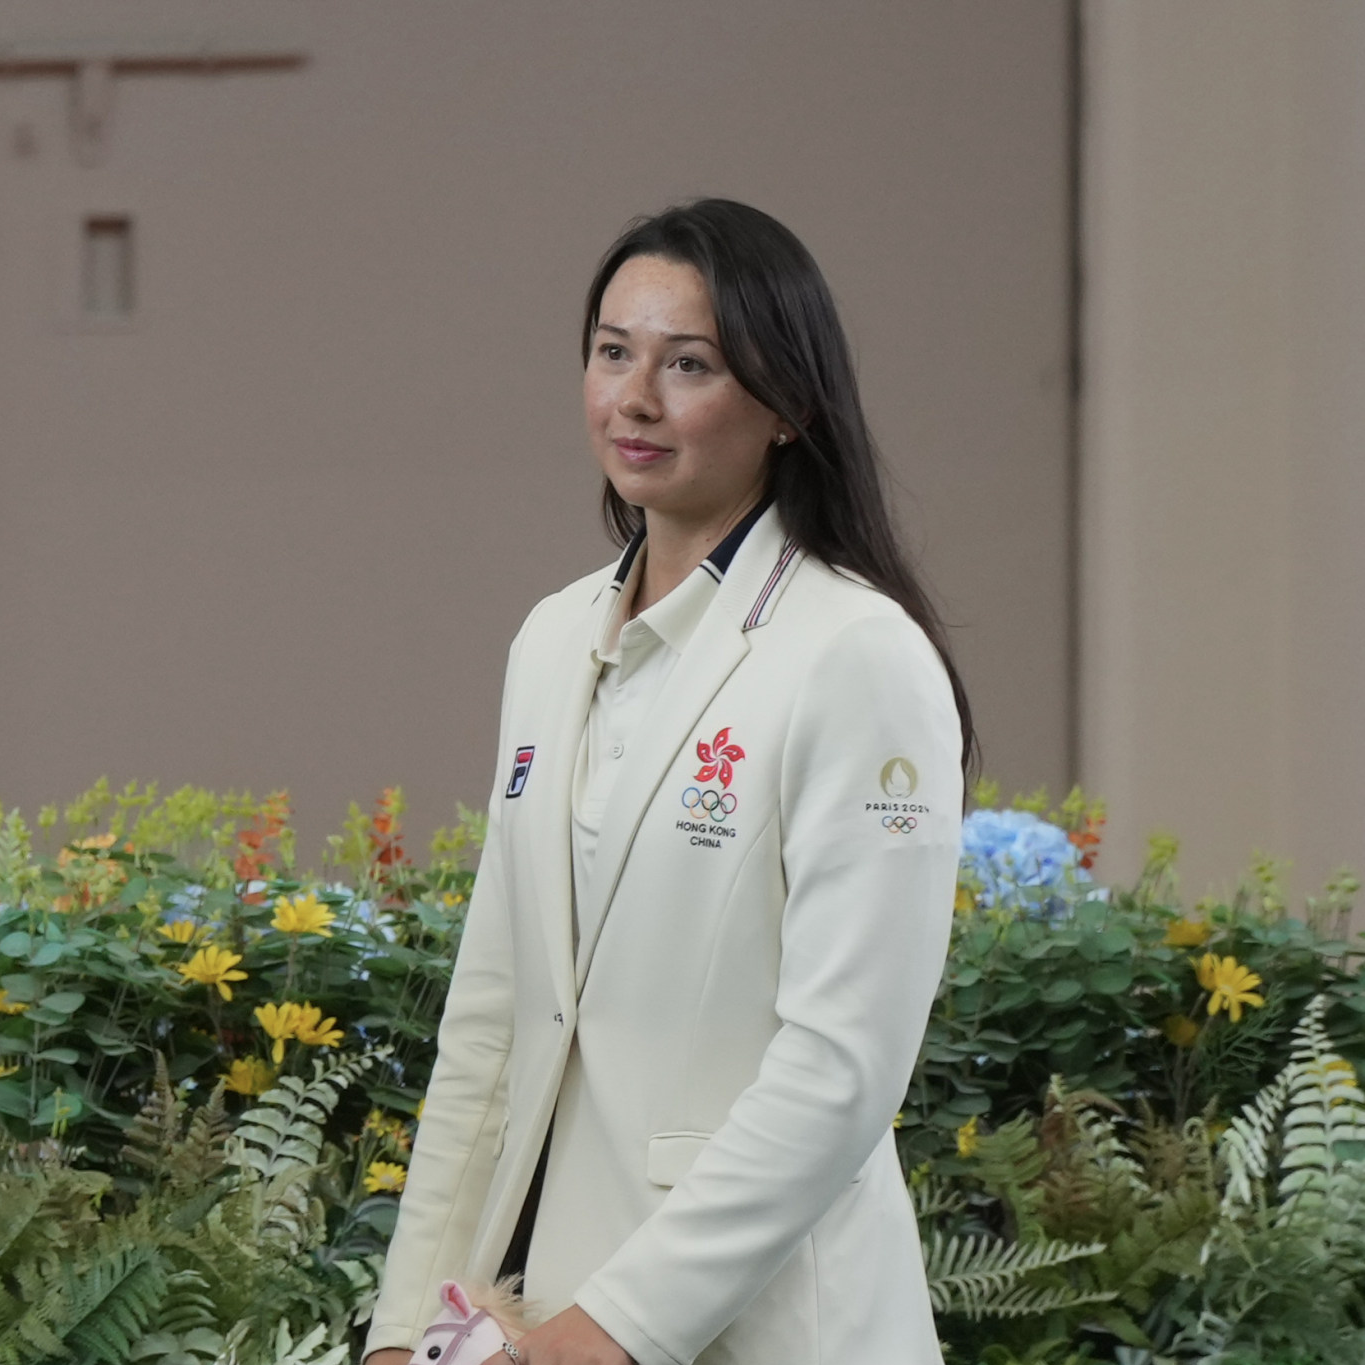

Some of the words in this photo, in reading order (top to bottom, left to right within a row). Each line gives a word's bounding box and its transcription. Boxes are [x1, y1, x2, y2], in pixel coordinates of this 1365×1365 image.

[902, 804, 929, 813] 2024
[676, 820, 707, 833] HONG
[709, 825, 736, 838] KONG
[690, 836, 722, 848] CHINA
